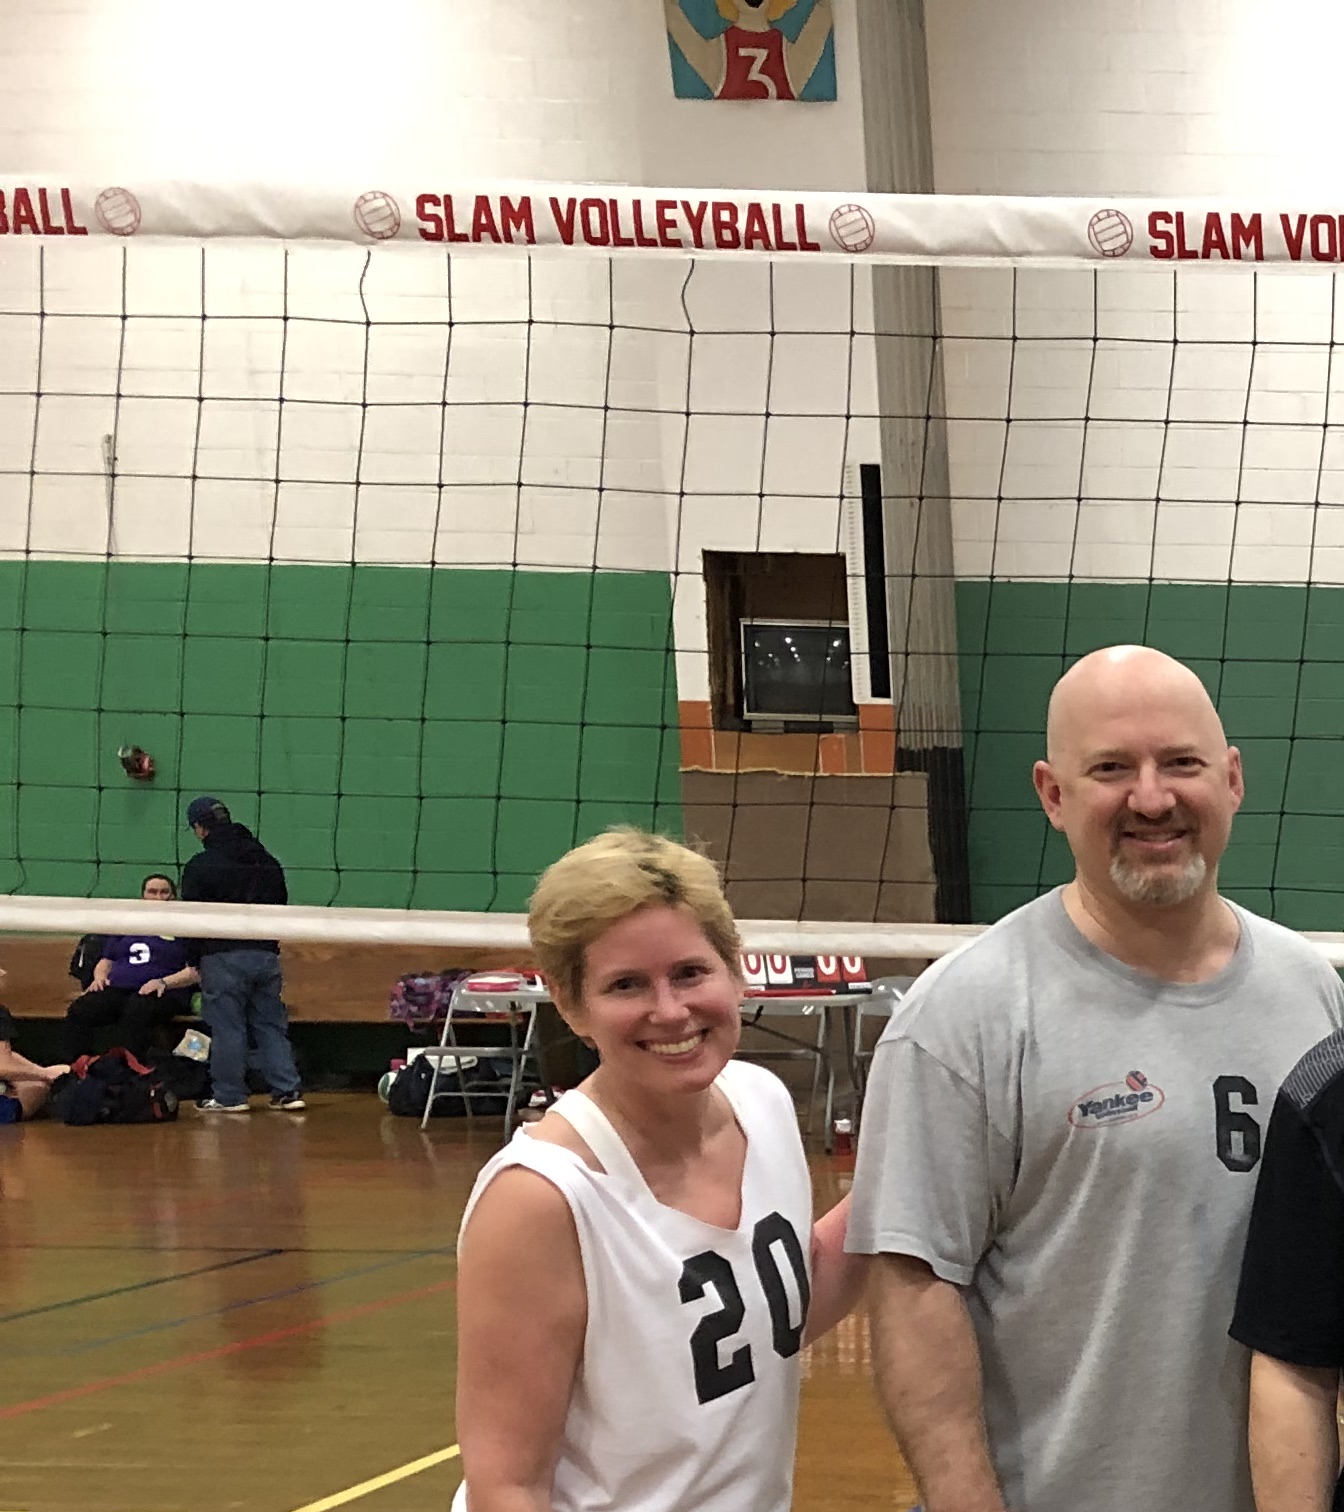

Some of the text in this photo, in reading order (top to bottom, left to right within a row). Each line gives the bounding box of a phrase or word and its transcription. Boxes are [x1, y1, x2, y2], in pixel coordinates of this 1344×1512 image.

[738, 48, 778, 99] 3
[415, 193, 820, 251] SLAM VOLLEYBALL
[1148, 211, 1263, 261] SLAM
[129, 943, 150, 965] 3
[1077, 1092, 1154, 1117] Yankee
[1212, 1075, 1261, 1173] 6
[678, 1211, 811, 1405] 20
